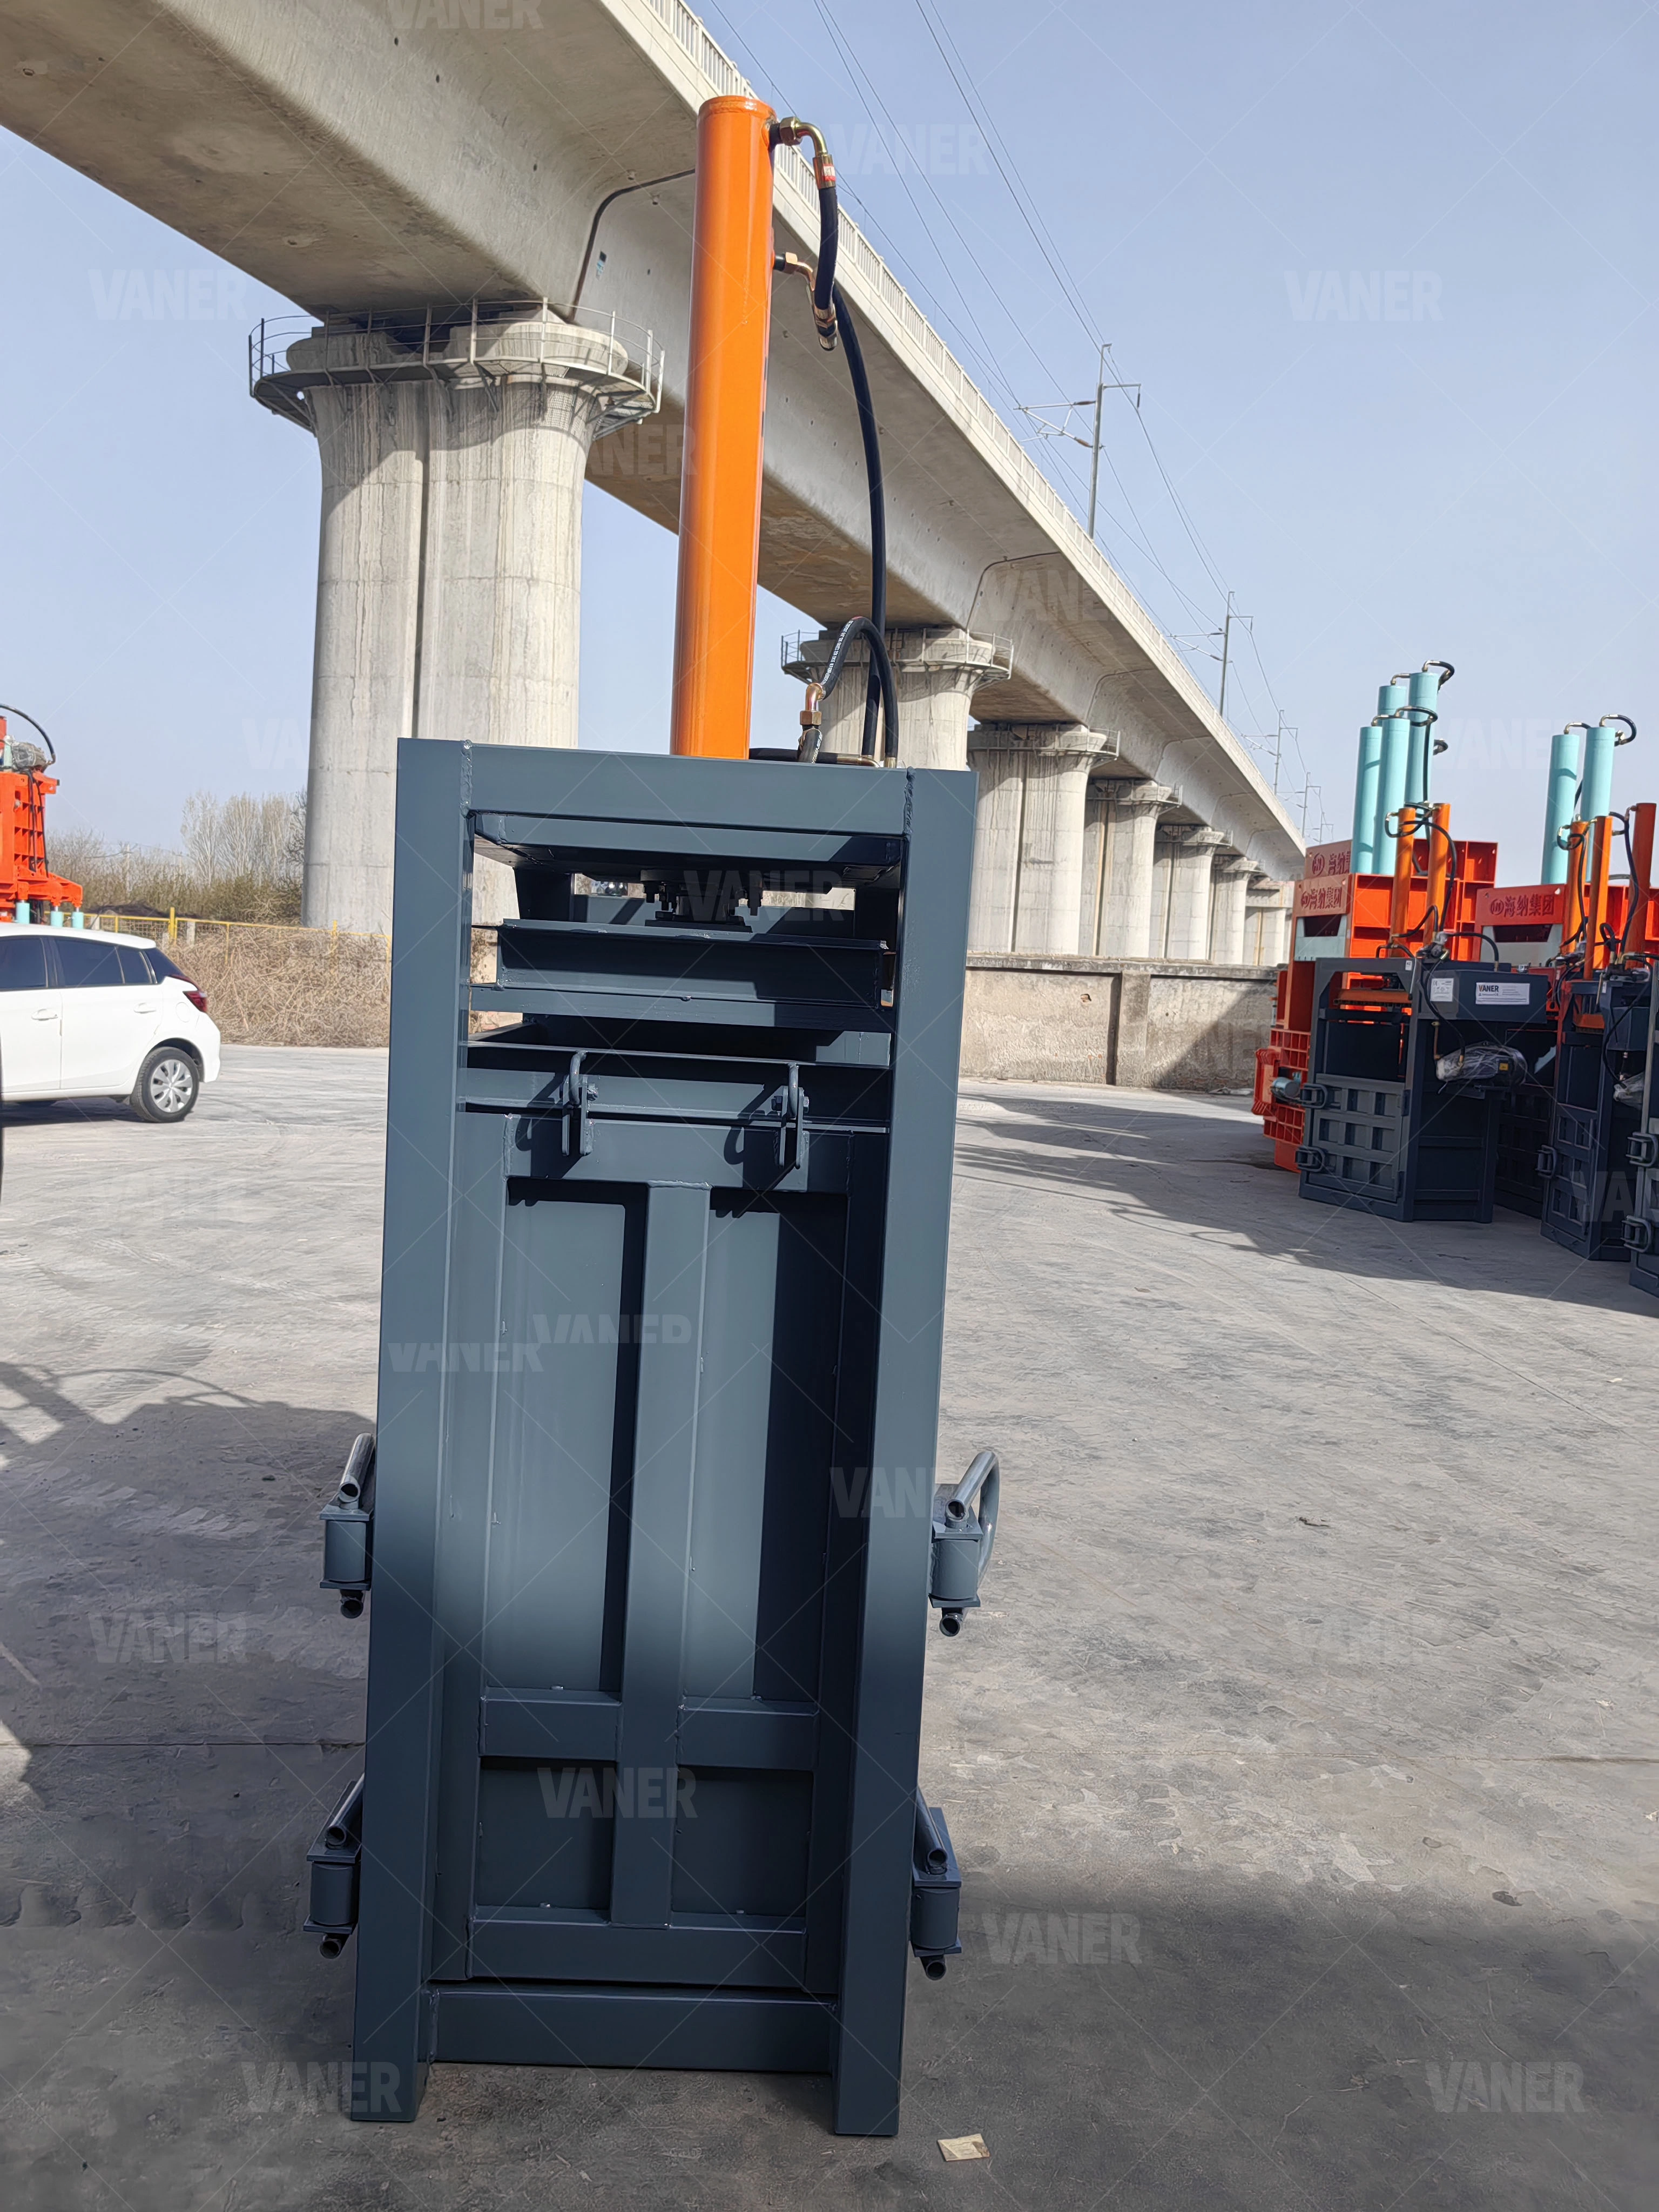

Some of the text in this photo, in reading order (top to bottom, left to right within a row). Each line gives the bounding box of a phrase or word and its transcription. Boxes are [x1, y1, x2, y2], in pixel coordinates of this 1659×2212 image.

[1309, 886, 1342, 910] 海纳集团
[1504, 894, 1554, 918] 海纳集团
[1479, 984, 1499, 993] VANER
